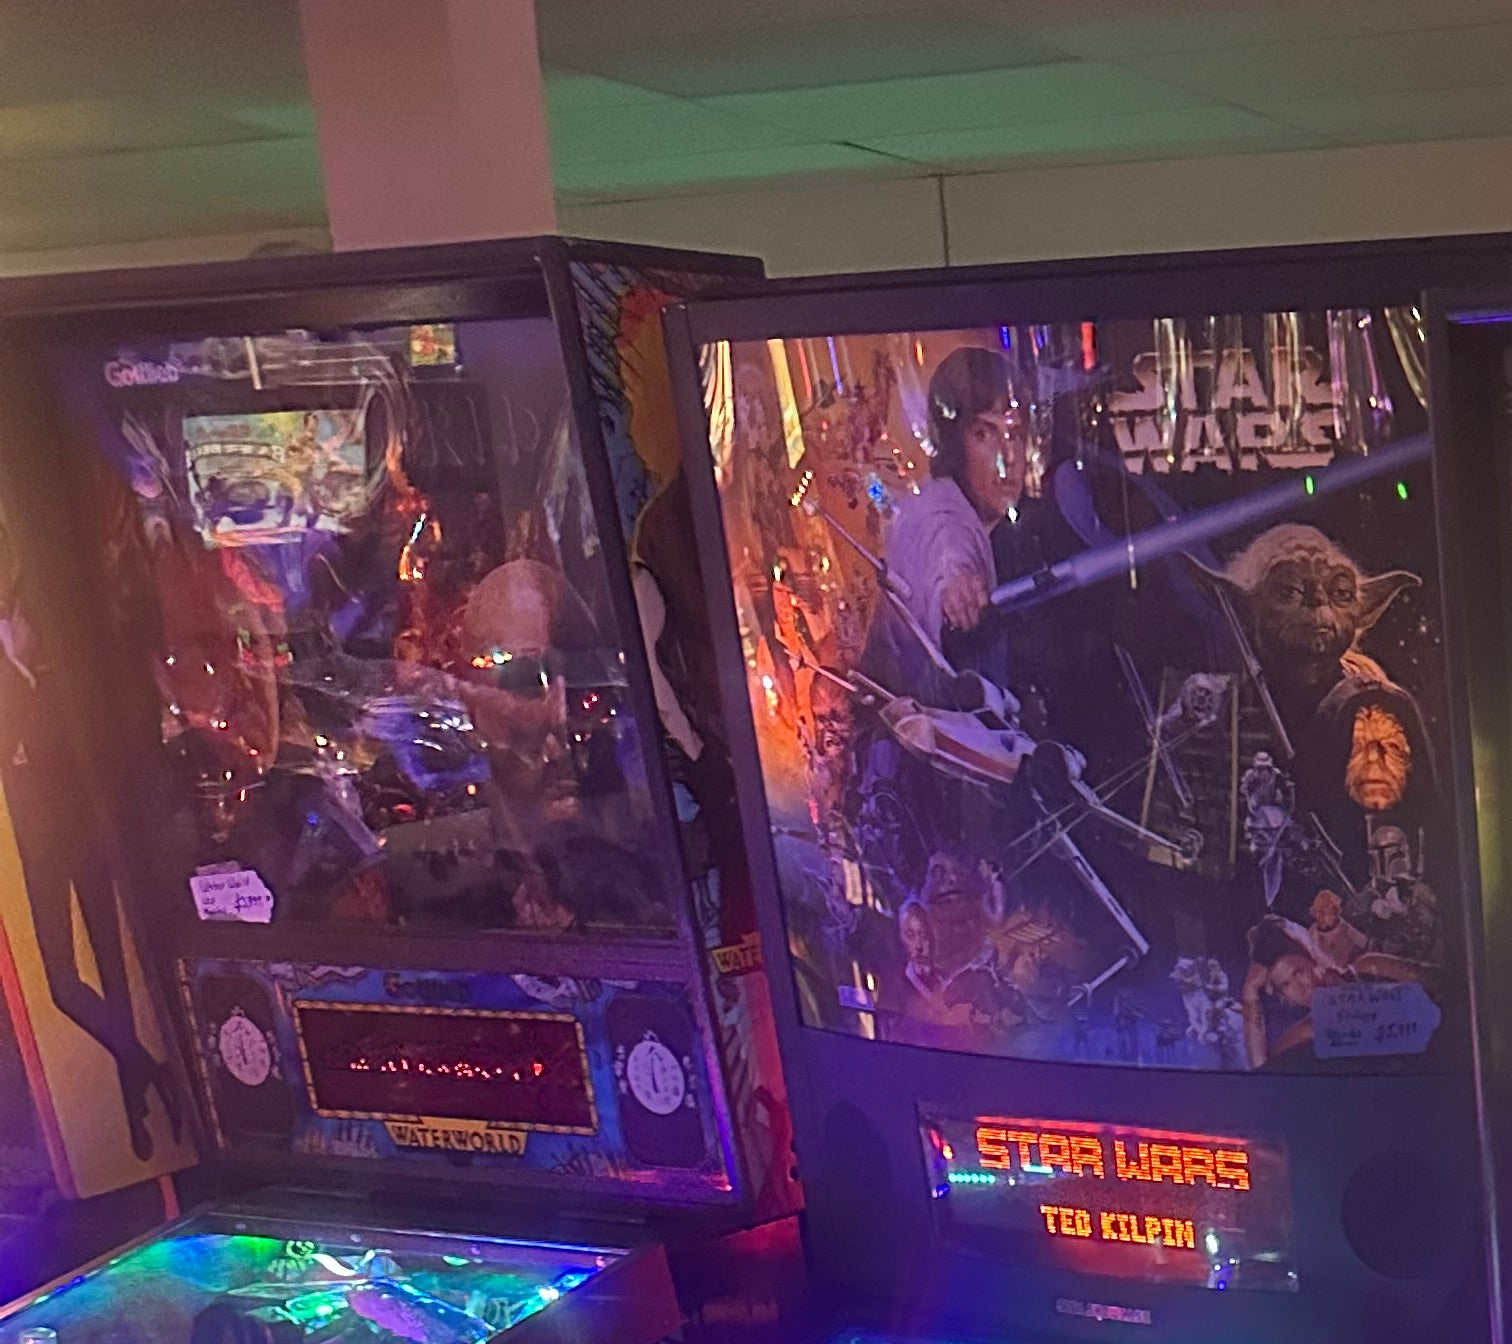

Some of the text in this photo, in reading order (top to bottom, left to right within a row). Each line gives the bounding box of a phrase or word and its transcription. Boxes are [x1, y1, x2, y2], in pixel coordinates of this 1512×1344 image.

[1107, 346, 1343, 411] STAR
[1109, 411, 1337, 475] WARS
[391, 1123, 524, 1154] WATERWORLD
[975, 1126, 1251, 1191] STAR WARS
[1040, 1204, 1196, 1249] TED KILPIN
